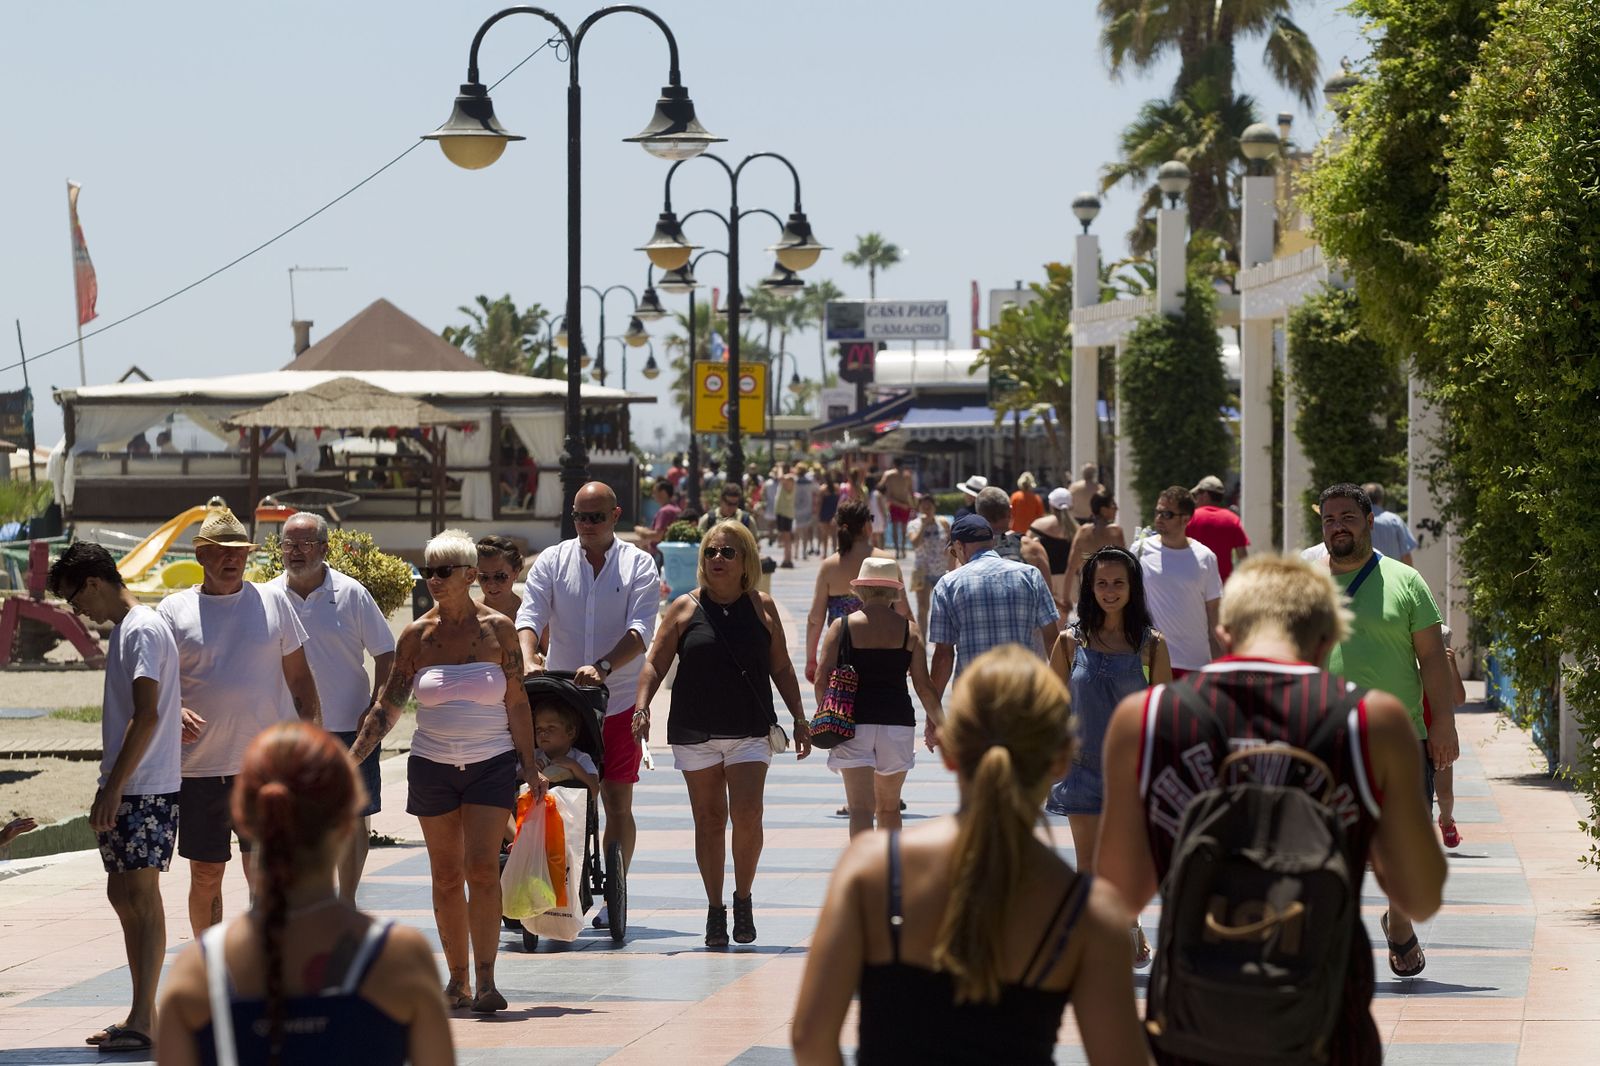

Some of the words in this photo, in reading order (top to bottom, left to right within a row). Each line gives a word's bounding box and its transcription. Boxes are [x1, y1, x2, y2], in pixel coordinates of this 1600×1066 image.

[867, 304, 904, 318] CASA
[906, 303, 947, 318] PACO
[872, 323, 942, 334] CAMACHO
[910, 426, 1015, 437] RESTAURANE
